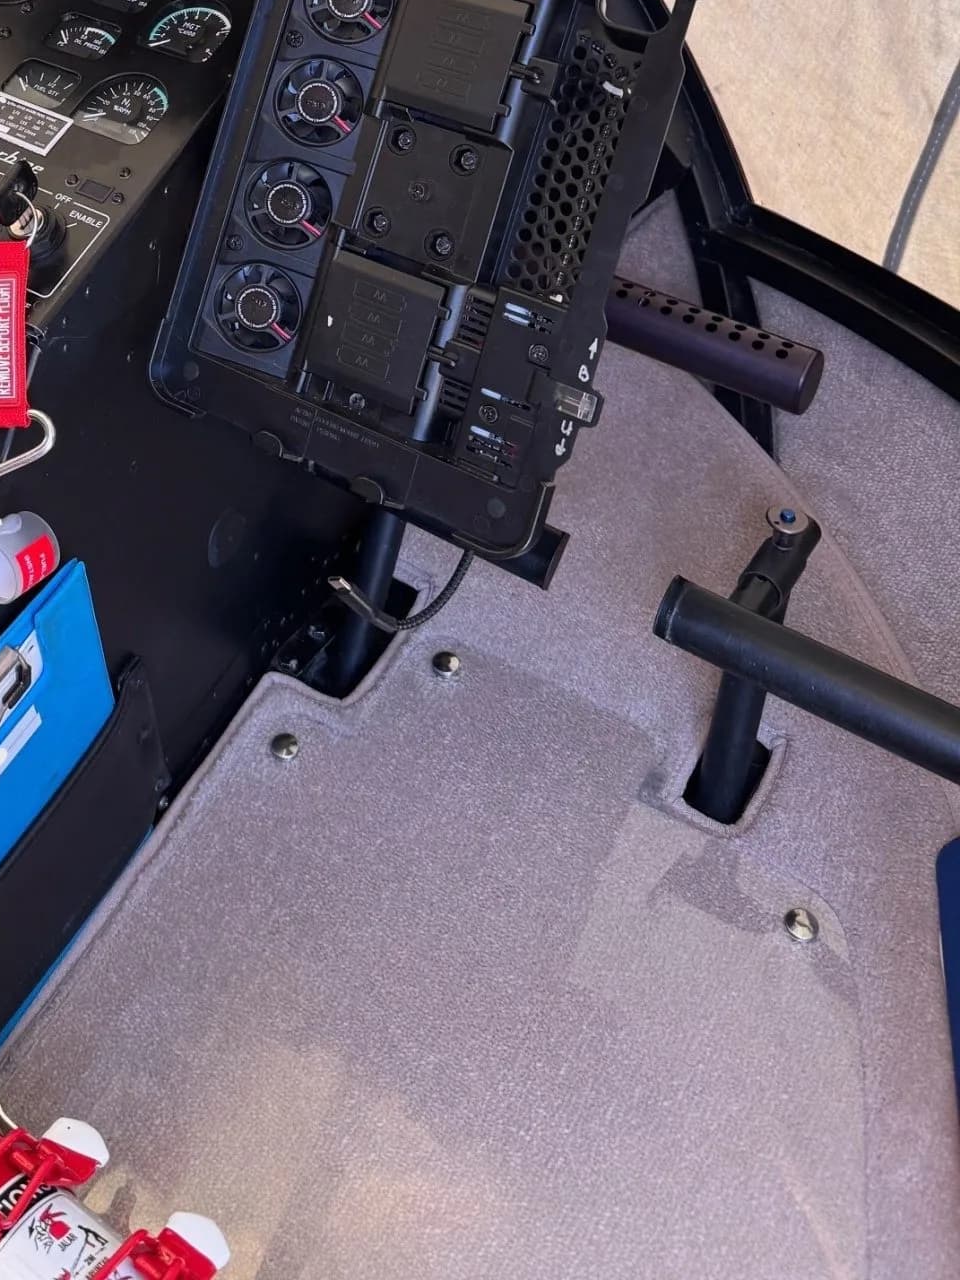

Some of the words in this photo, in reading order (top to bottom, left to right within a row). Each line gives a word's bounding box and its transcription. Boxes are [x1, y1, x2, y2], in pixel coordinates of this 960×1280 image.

[33, 84, 47, 95] FUEL
[55, 193, 73, 204] OFF
[69, 209, 103, 229] ENABLE
[57, 1232, 79, 1253] JALAR
